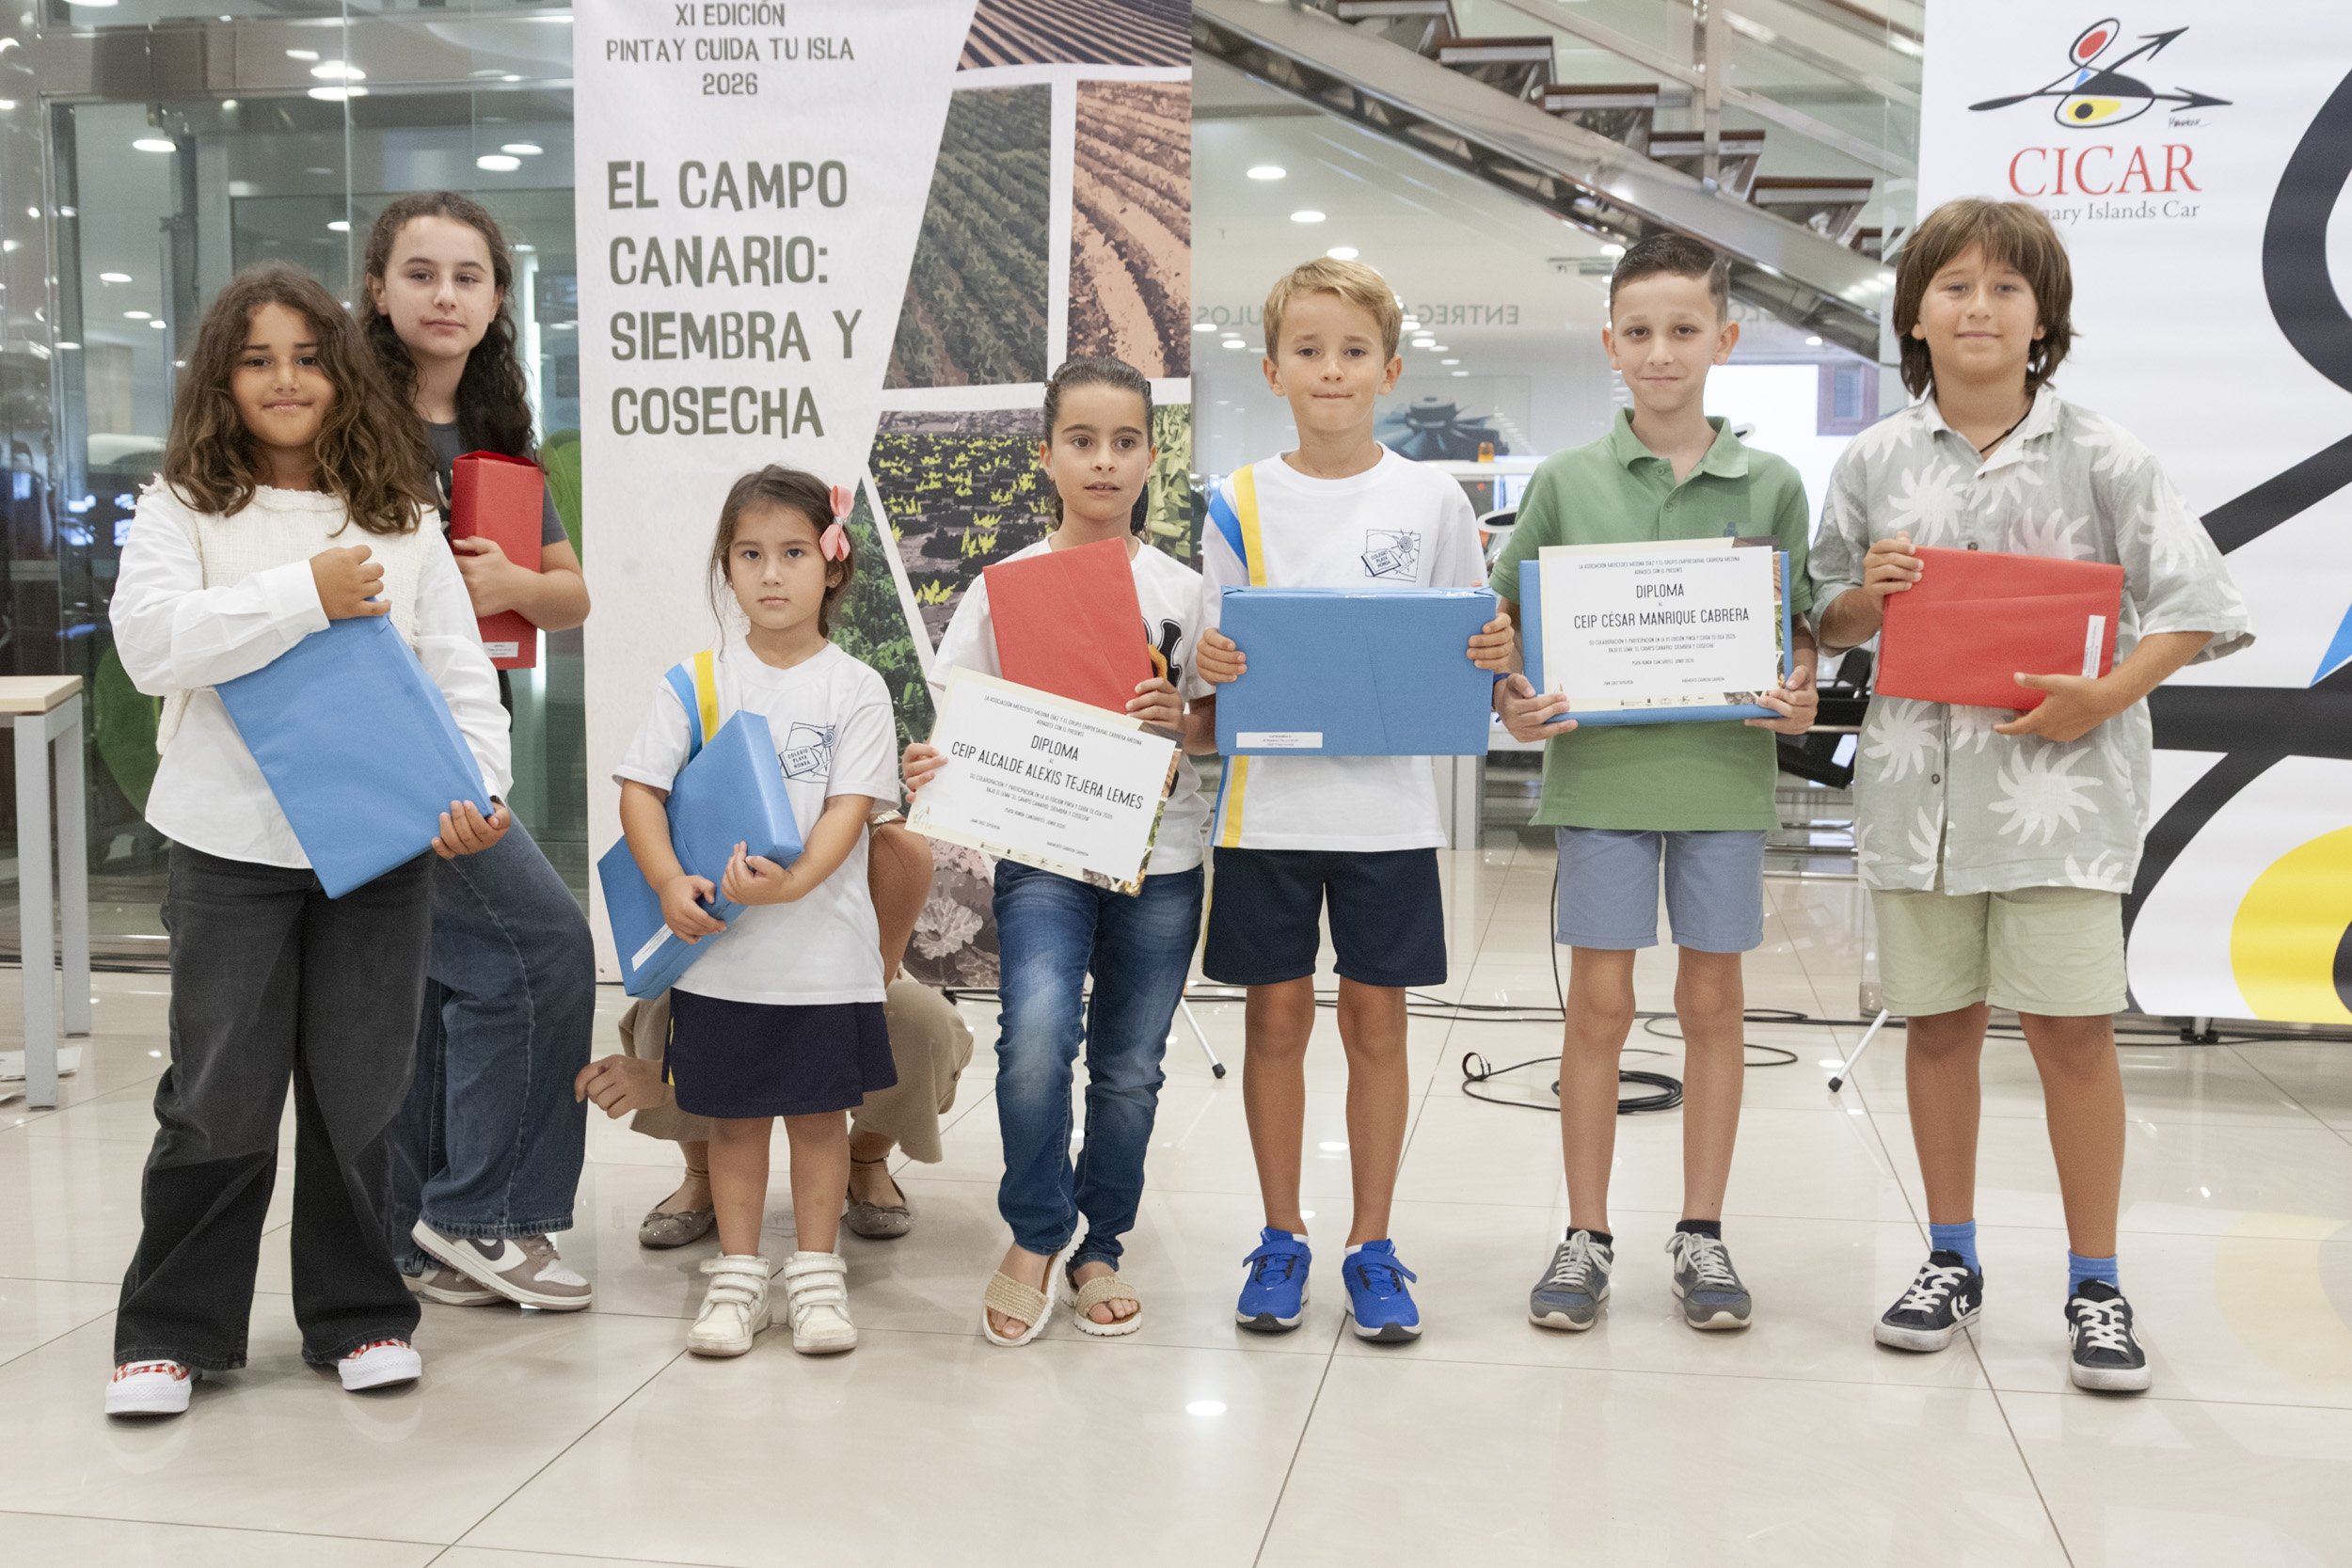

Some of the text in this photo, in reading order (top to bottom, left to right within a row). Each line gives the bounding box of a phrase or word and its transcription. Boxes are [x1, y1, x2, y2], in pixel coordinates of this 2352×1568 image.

[675, 4, 695, 26] XI
[694, 37, 759, 61] CUIDA
[769, 37, 799, 61] TU
[807, 37, 854, 60] ISLA
[702, 71, 758, 96] 2026
[2008, 144, 2202, 198] CICAR
[607, 159, 848, 212] EL CAMPO
[2088, 200, 2156, 219] Islands
[2163, 200, 2201, 218] Car
[609, 234, 829, 289] CANARIO:
[610, 309, 863, 363] SIEMBRA Y
[611, 386, 825, 440] COSECHA
[1635, 583, 1684, 598] DIPLOMA
[1574, 607, 1749, 628] CEIP CÉSAR MANRIQUE CABRERA
[1030, 735, 1080, 761] DIPLOMA
[950, 740, 1143, 810] CEIP ALCALDE ALEXIS TEJERA LEMES
